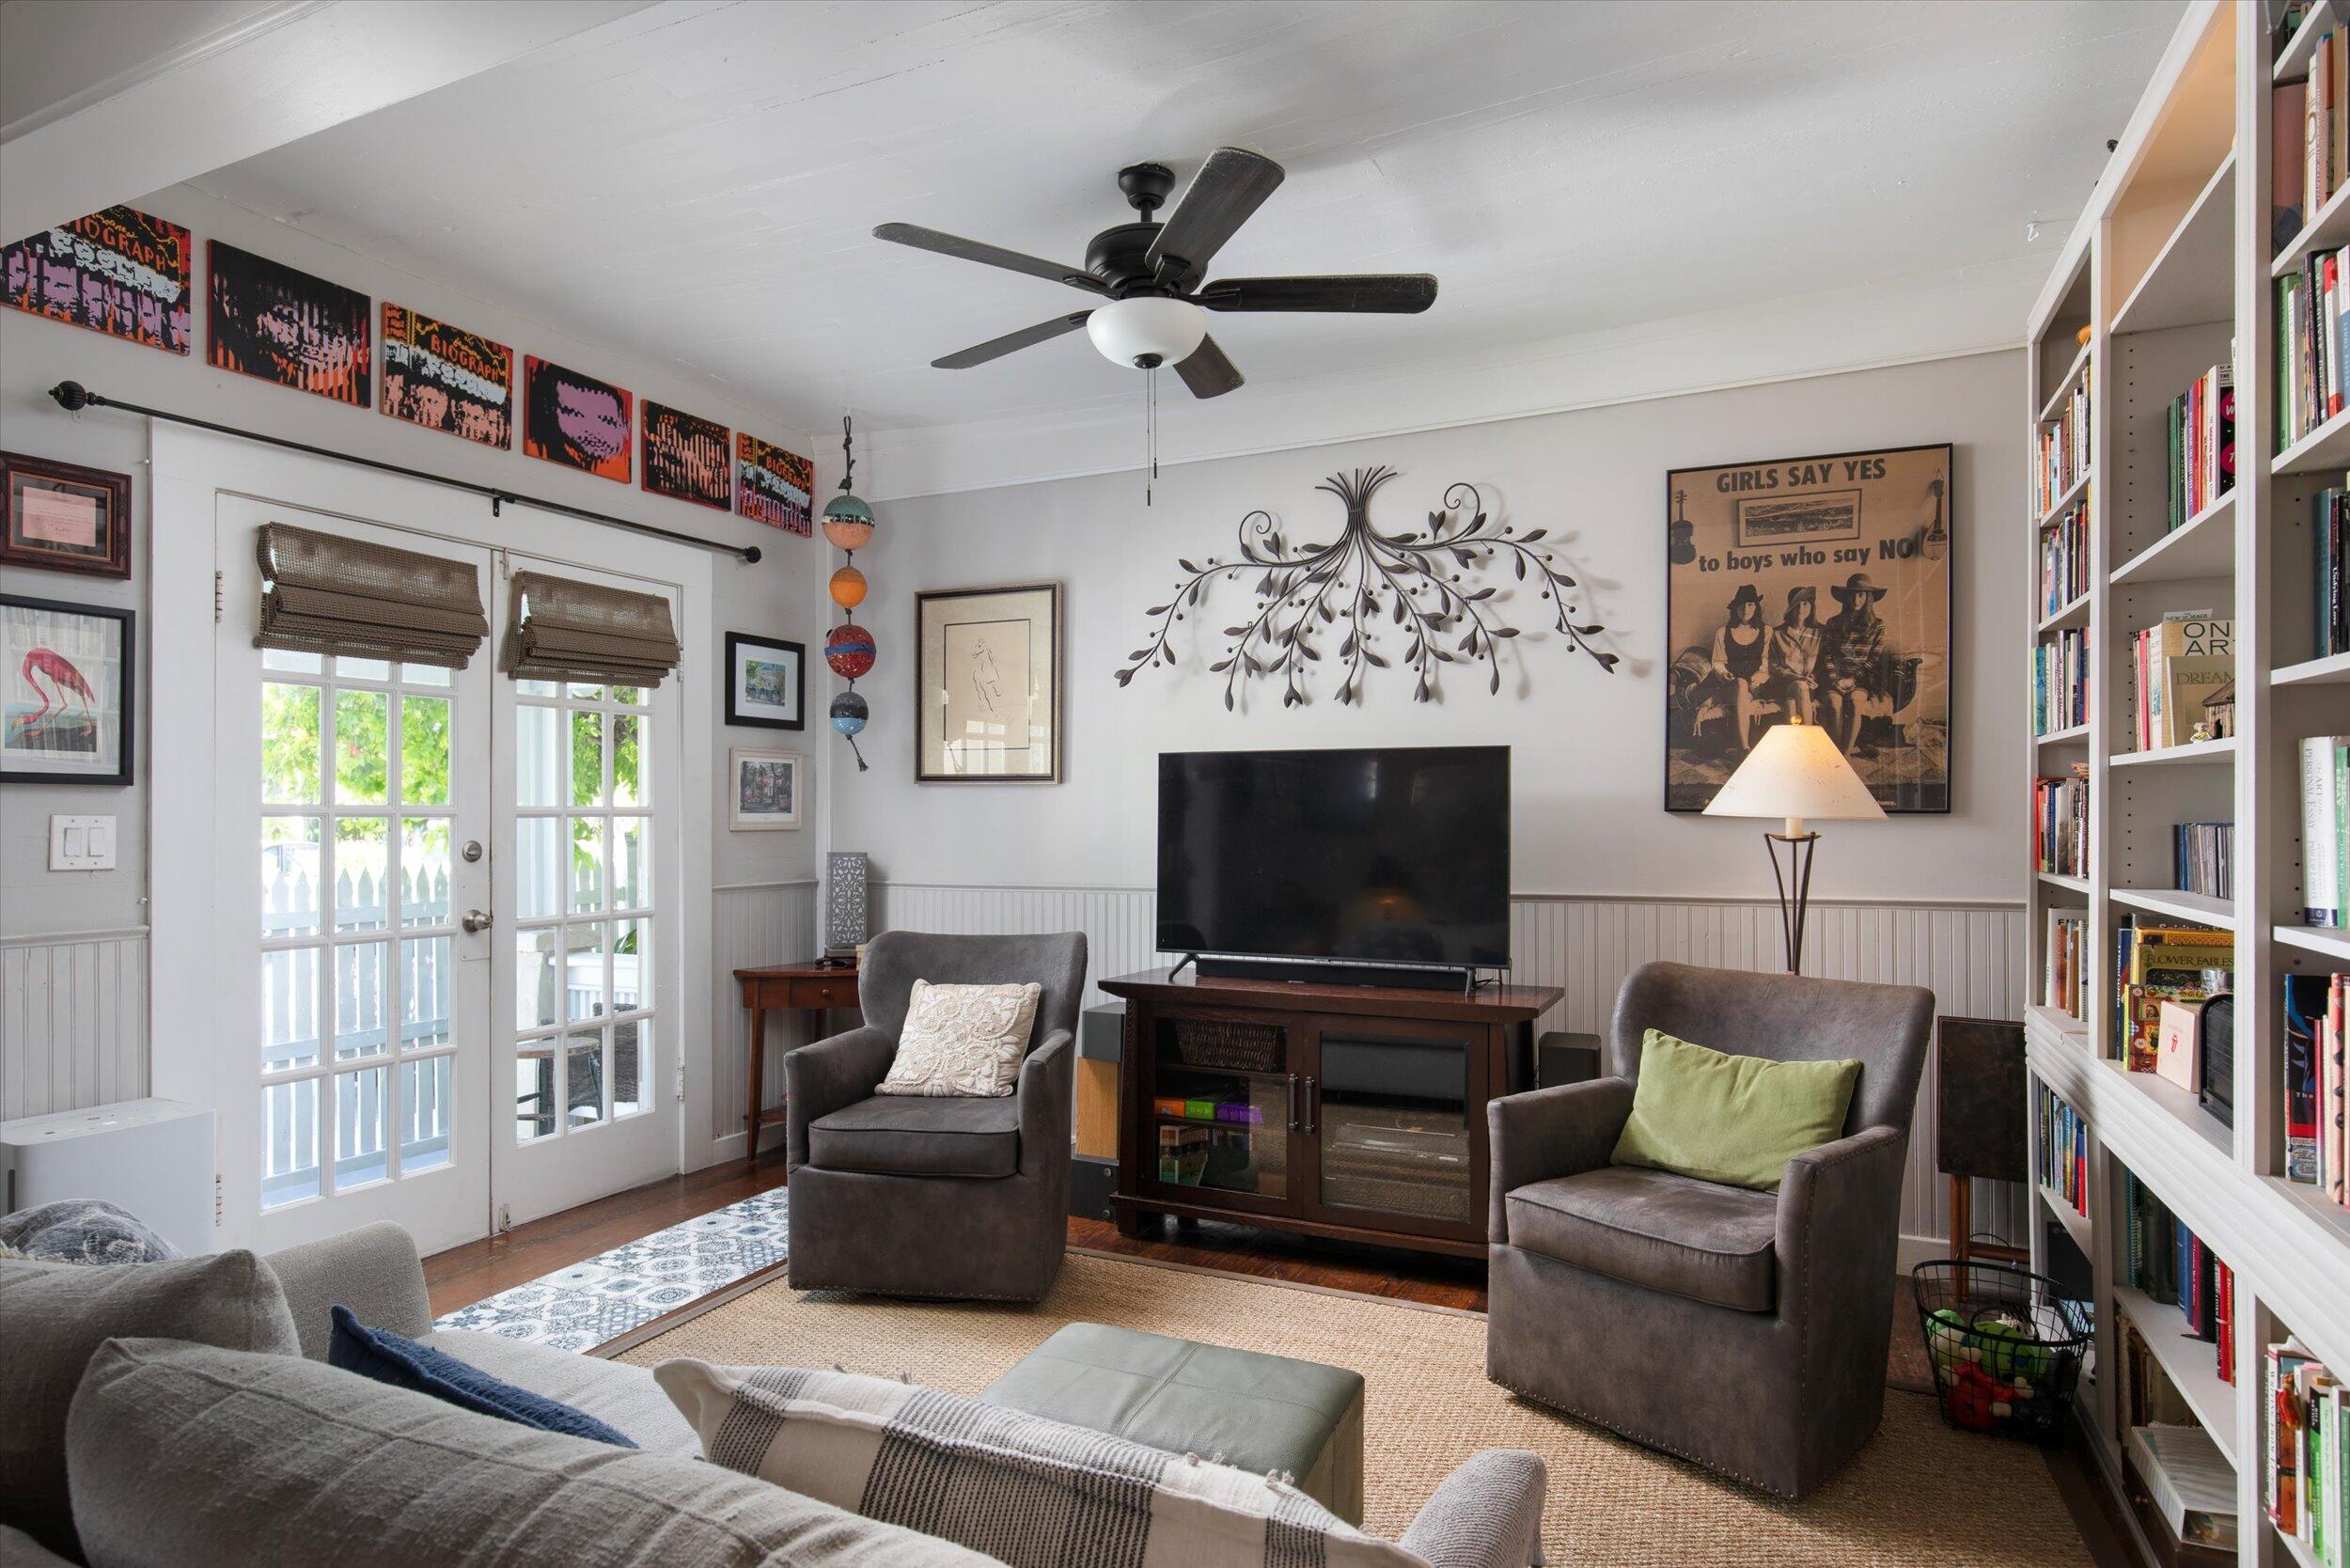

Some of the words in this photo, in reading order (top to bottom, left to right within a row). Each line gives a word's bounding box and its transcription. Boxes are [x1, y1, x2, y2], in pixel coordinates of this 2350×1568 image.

[63, 216, 166, 272] IOGRAPH
[431, 334, 499, 381] BIOGRAPH
[1716, 468, 1778, 494] GIRLS
[1788, 463, 1833, 487] SAY
[1843, 458, 1887, 481] YES
[1699, 557, 1720, 572] to
[1727, 551, 1773, 572] boys
[1780, 545, 1826, 566] who
[1834, 547, 1871, 565] say
[1880, 536, 1914, 559] NO
[2182, 613, 2208, 621] YORKER
[2184, 622, 2230, 637] ON
[2184, 640, 2235, 655] AR
[2305, 748, 2314, 798] PERSONAL
[2307, 801, 2316, 828] ESSAY
[2143, 953, 2197, 966] FLOWER
[2198, 956, 2234, 966] FABLES
